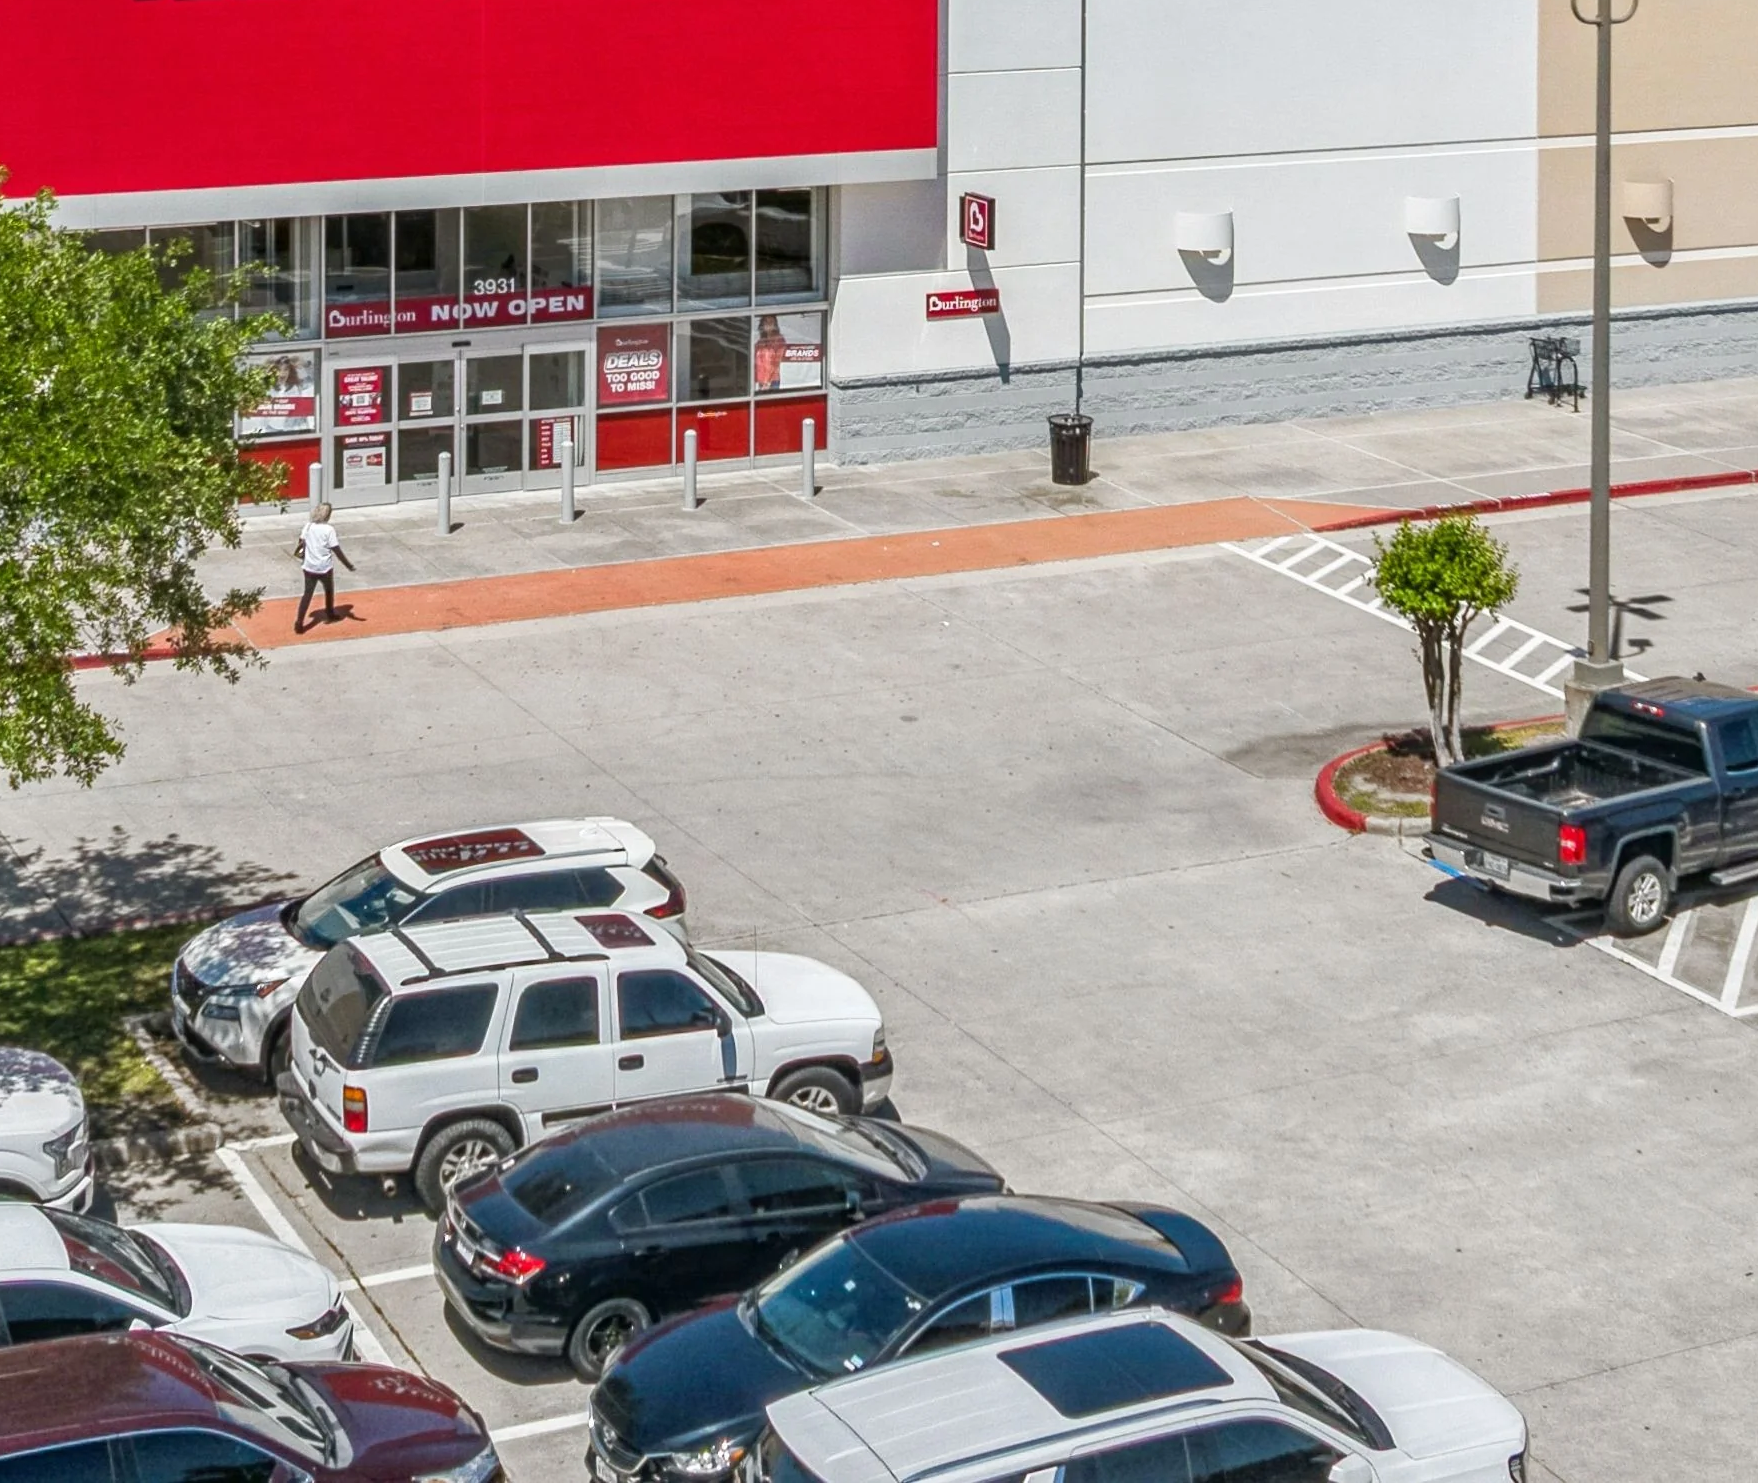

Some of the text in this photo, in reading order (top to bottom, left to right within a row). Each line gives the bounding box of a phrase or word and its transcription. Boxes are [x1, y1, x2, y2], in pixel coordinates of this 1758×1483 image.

[473, 278, 515, 295] 3931
[329, 295, 585, 328] Burlingon NOW OPEN
[928, 296, 997, 313] Burlington
[606, 352, 659, 369] DEALS
[606, 371, 660, 383] TOO GOOD
[610, 381, 656, 393] TO MISS!
